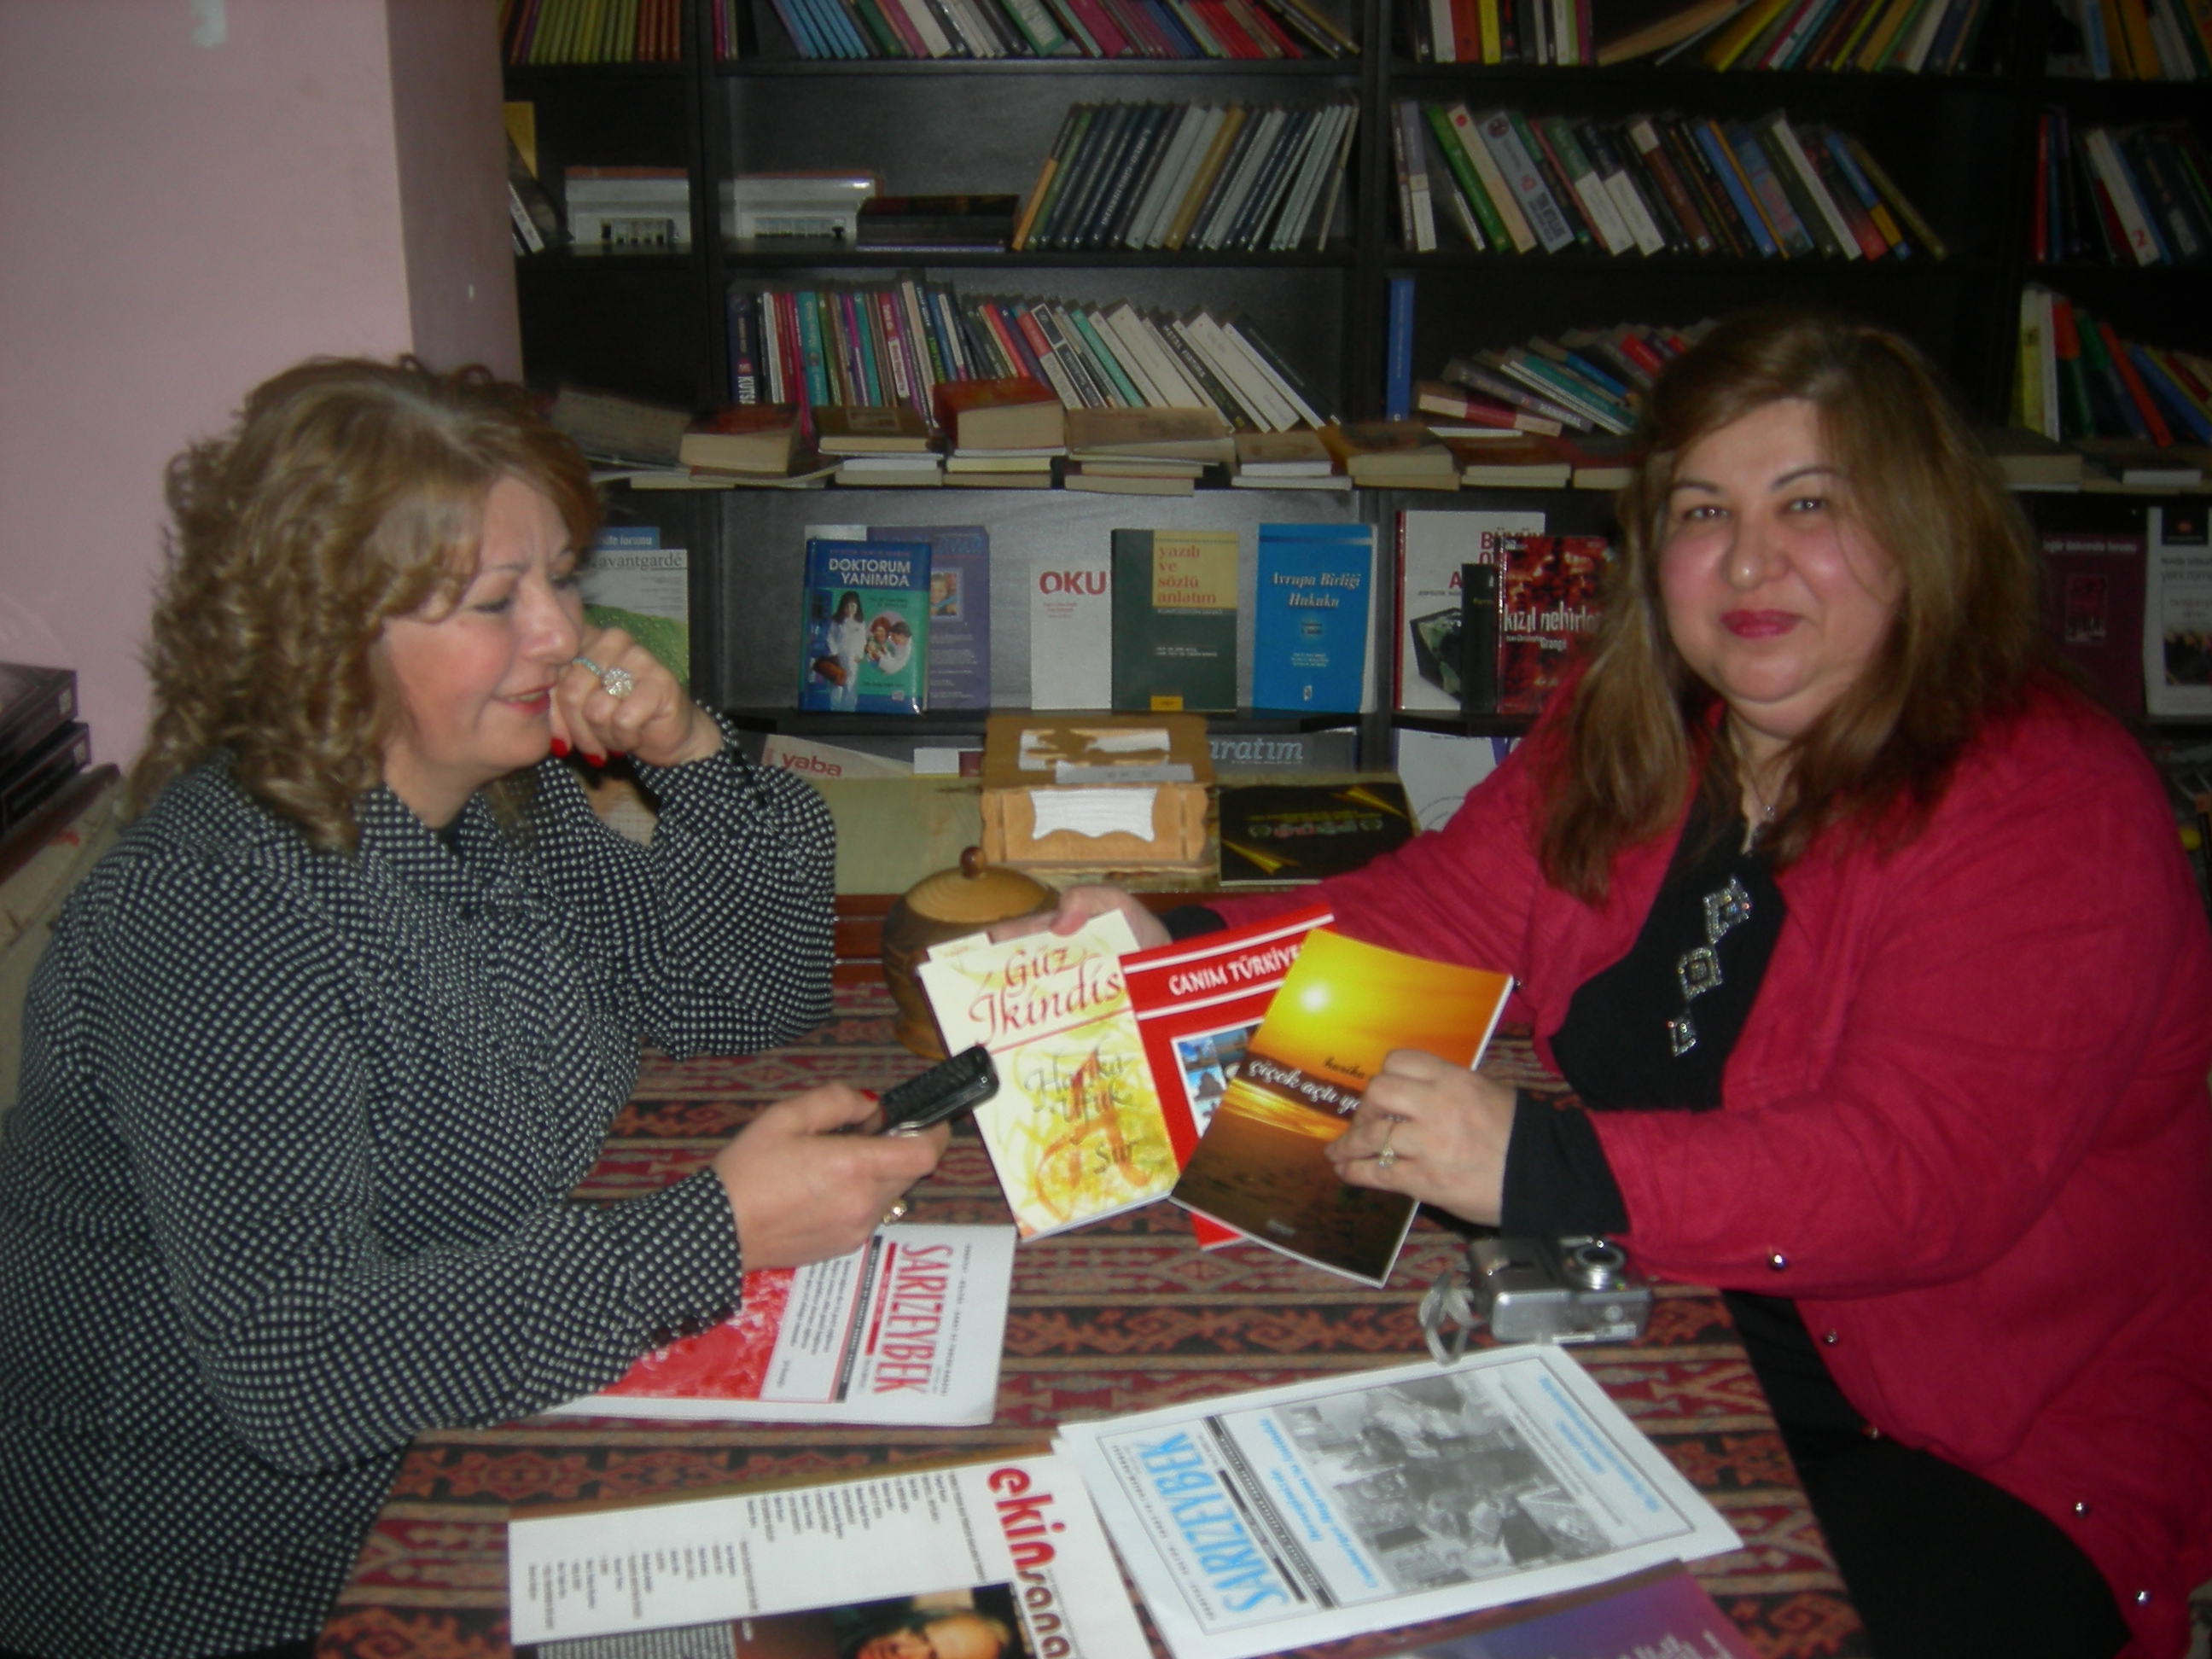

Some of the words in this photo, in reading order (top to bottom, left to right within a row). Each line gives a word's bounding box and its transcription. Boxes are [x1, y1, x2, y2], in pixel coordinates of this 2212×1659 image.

[829, 558, 911, 573] DOKTORUM
[1158, 561, 1177, 572] ve
[841, 573, 910, 587] YANIMDA
[1039, 571, 1107, 596] OKU
[1157, 574, 1199, 589] sözlü
[1271, 572, 1316, 589] Avrupa
[1319, 573, 1361, 590] Birliği
[1157, 591, 1217, 604] anlatım
[1289, 593, 1339, 608] Hukuku
[1504, 604, 1536, 632] kızıl
[783, 753, 842, 777] yaba
[1004, 940, 1075, 994] Güz
[1167, 964, 1228, 997] CANIM
[1248, 1058, 1301, 1091] çiçek
[1300, 1079, 1340, 1109] açtı
[1336, 1094, 1362, 1117] ya
[874, 1244, 953, 1393] SARIZEYBEK
[1138, 1432, 1288, 1610] SARIZEYBEK
[987, 1466, 1072, 1659] ekinsana
